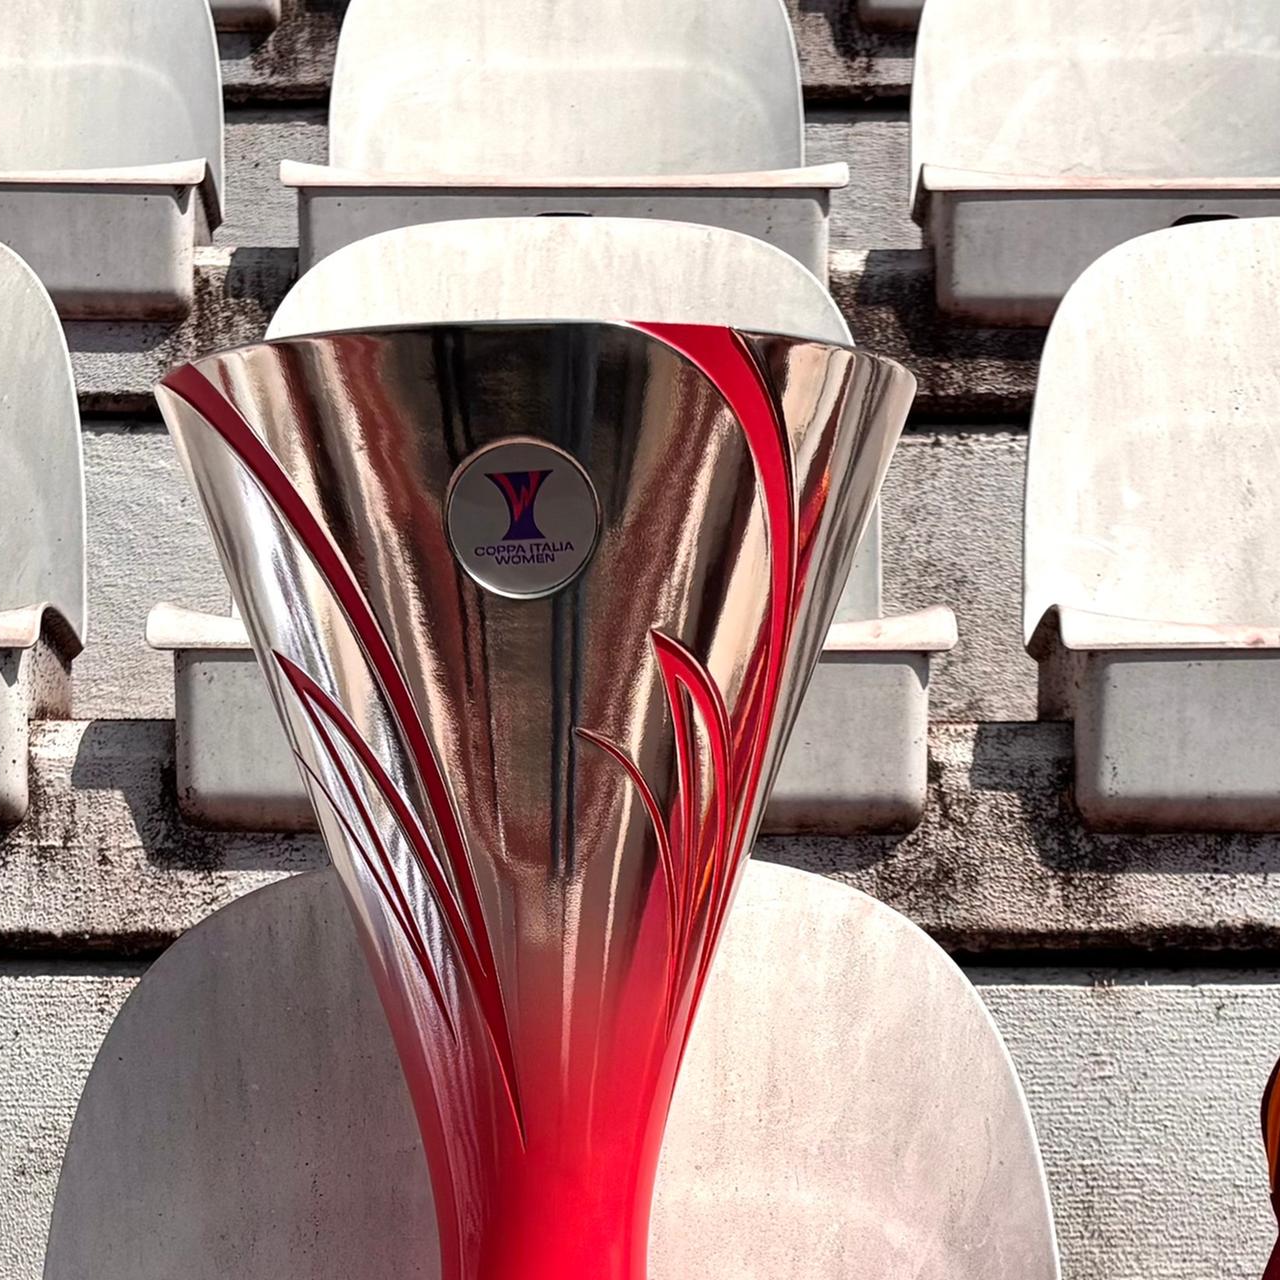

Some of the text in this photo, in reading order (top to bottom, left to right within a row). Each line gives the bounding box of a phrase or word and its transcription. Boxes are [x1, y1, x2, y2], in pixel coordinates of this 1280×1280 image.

[474, 541, 574, 556] COPPA ITALIA
[494, 553, 555, 565] WOMEN
